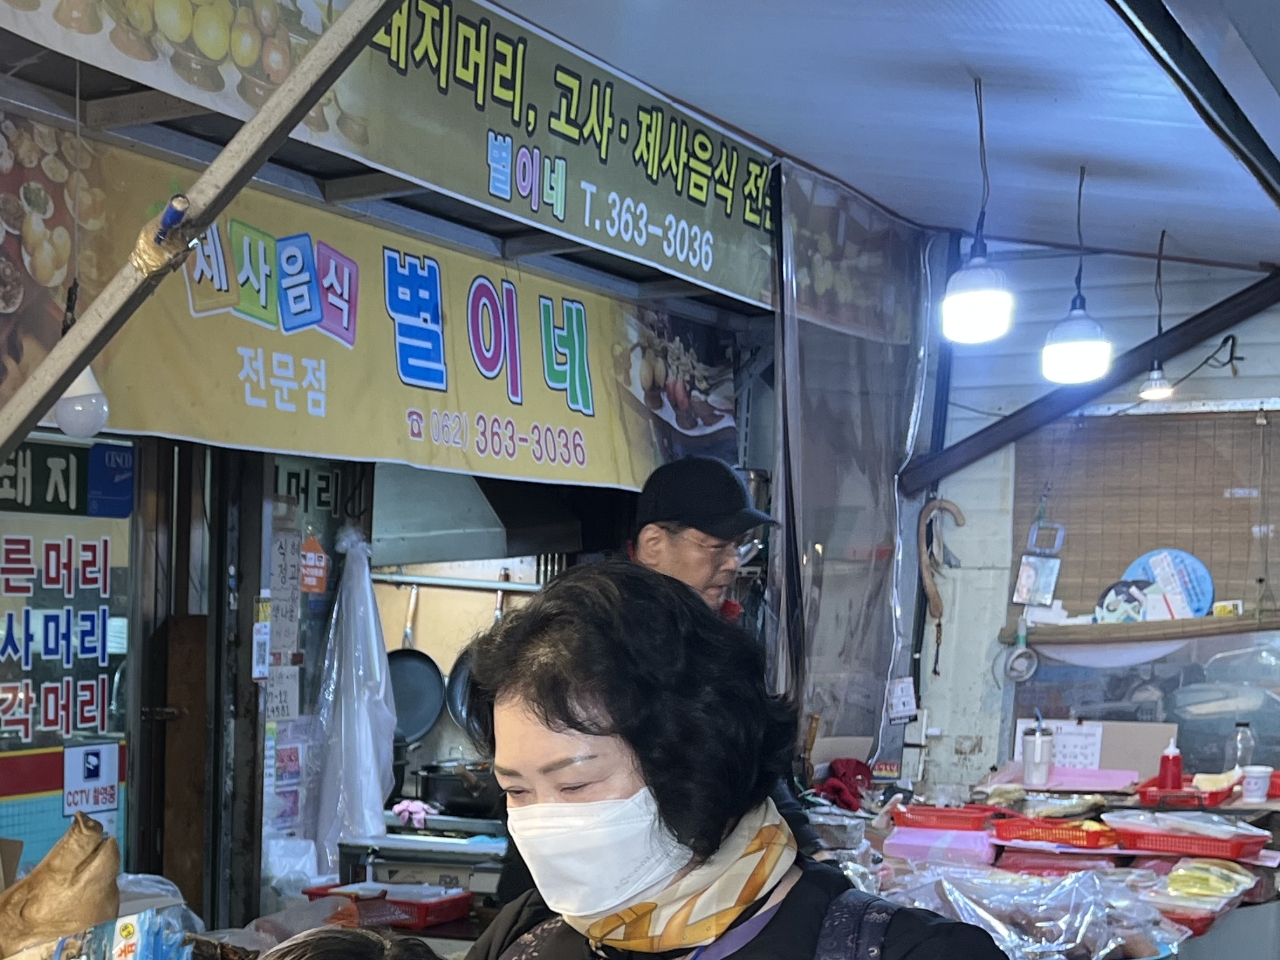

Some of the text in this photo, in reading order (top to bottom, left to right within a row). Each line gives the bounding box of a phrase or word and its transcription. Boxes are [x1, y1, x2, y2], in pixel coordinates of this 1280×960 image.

[743, 159, 776, 231] 전
[193, 221, 351, 330] 제사음식
[236, 346, 327, 418] 전문점
[474, 411, 587, 468] 363-3036
[65, 784, 116, 808] CCTV 촬영중
